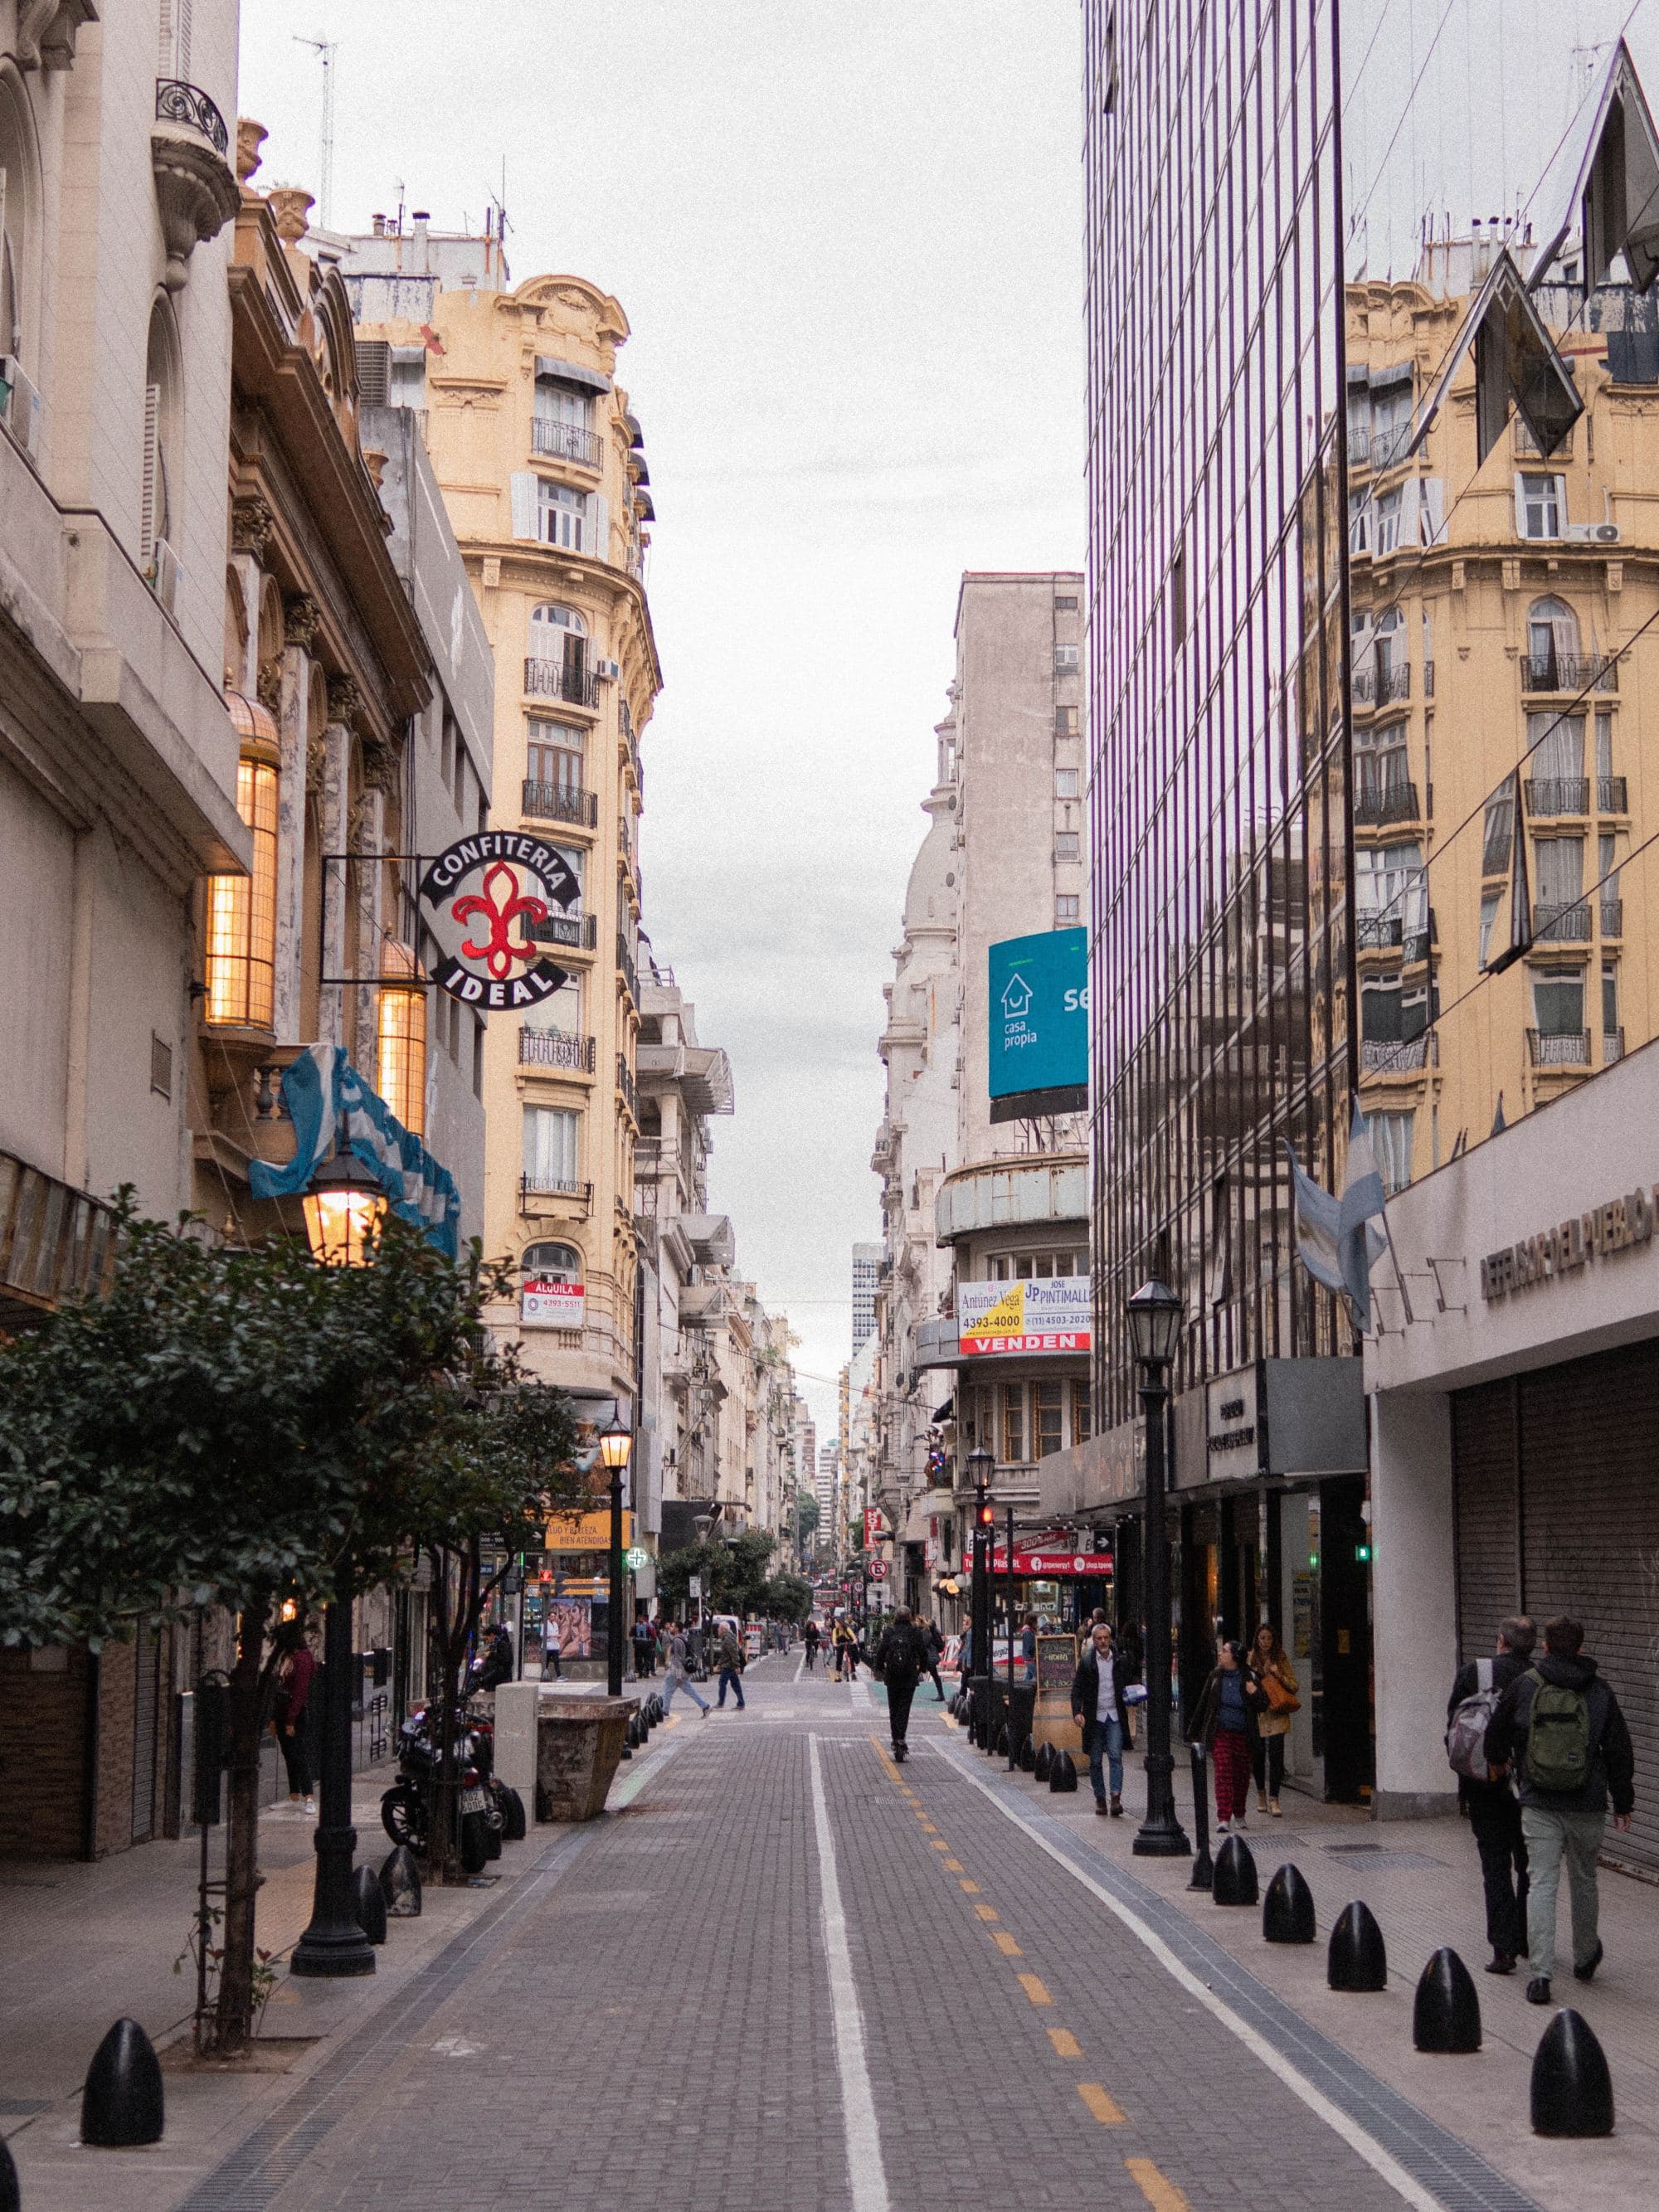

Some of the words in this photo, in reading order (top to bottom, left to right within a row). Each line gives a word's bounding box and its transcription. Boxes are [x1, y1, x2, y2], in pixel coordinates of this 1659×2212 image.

[433, 835, 567, 890] CONFITERIA
[445, 969, 553, 1005] IDEAL
[1005, 1020, 1026, 1034] casa
[1005, 1030, 1037, 1051] propia
[535, 1283, 574, 1295] ALQUILA
[1051, 1280, 1065, 1289] JOSE
[1025, 1284, 1039, 1302] JP
[1040, 1290, 1089, 1304] PINTIMALL
[1000, 1291, 1019, 1310] Vega
[963, 1315, 1019, 1329] 4393-4000
[1032, 1316, 1044, 1325] (11)
[1046, 1315, 1090, 1325] 4503-2020
[975, 1334, 1076, 1352] VENDEN
[559, 1536, 577, 1545] BIEN
